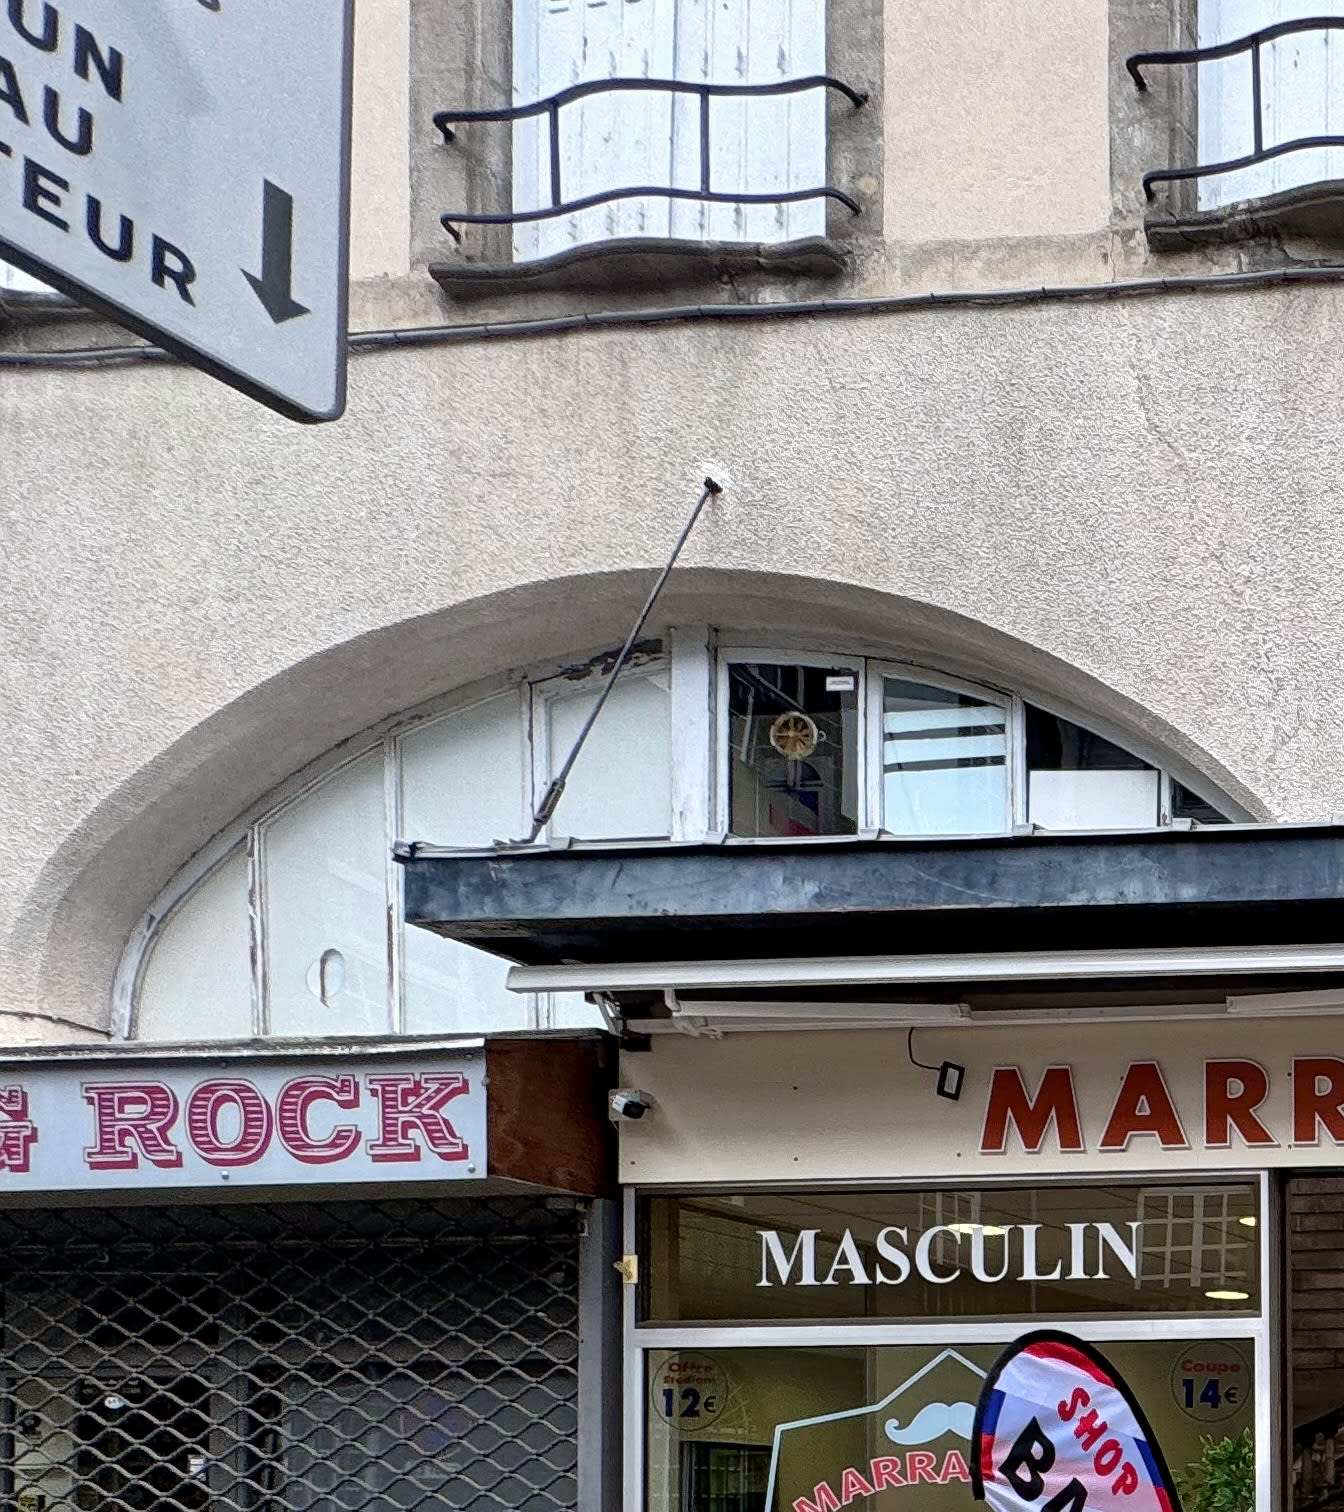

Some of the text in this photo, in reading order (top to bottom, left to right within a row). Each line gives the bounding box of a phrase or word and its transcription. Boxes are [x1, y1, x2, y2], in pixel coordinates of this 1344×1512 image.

[0, 140, 196, 308] EUR
[81, 1072, 470, 1170] ROCK
[755, 1221, 1142, 1288] MASCULIN
[663, 1388, 716, 1418] 12€
[1183, 1378, 1238, 1408] 14€
[1056, 1386, 1140, 1497] SHOP
